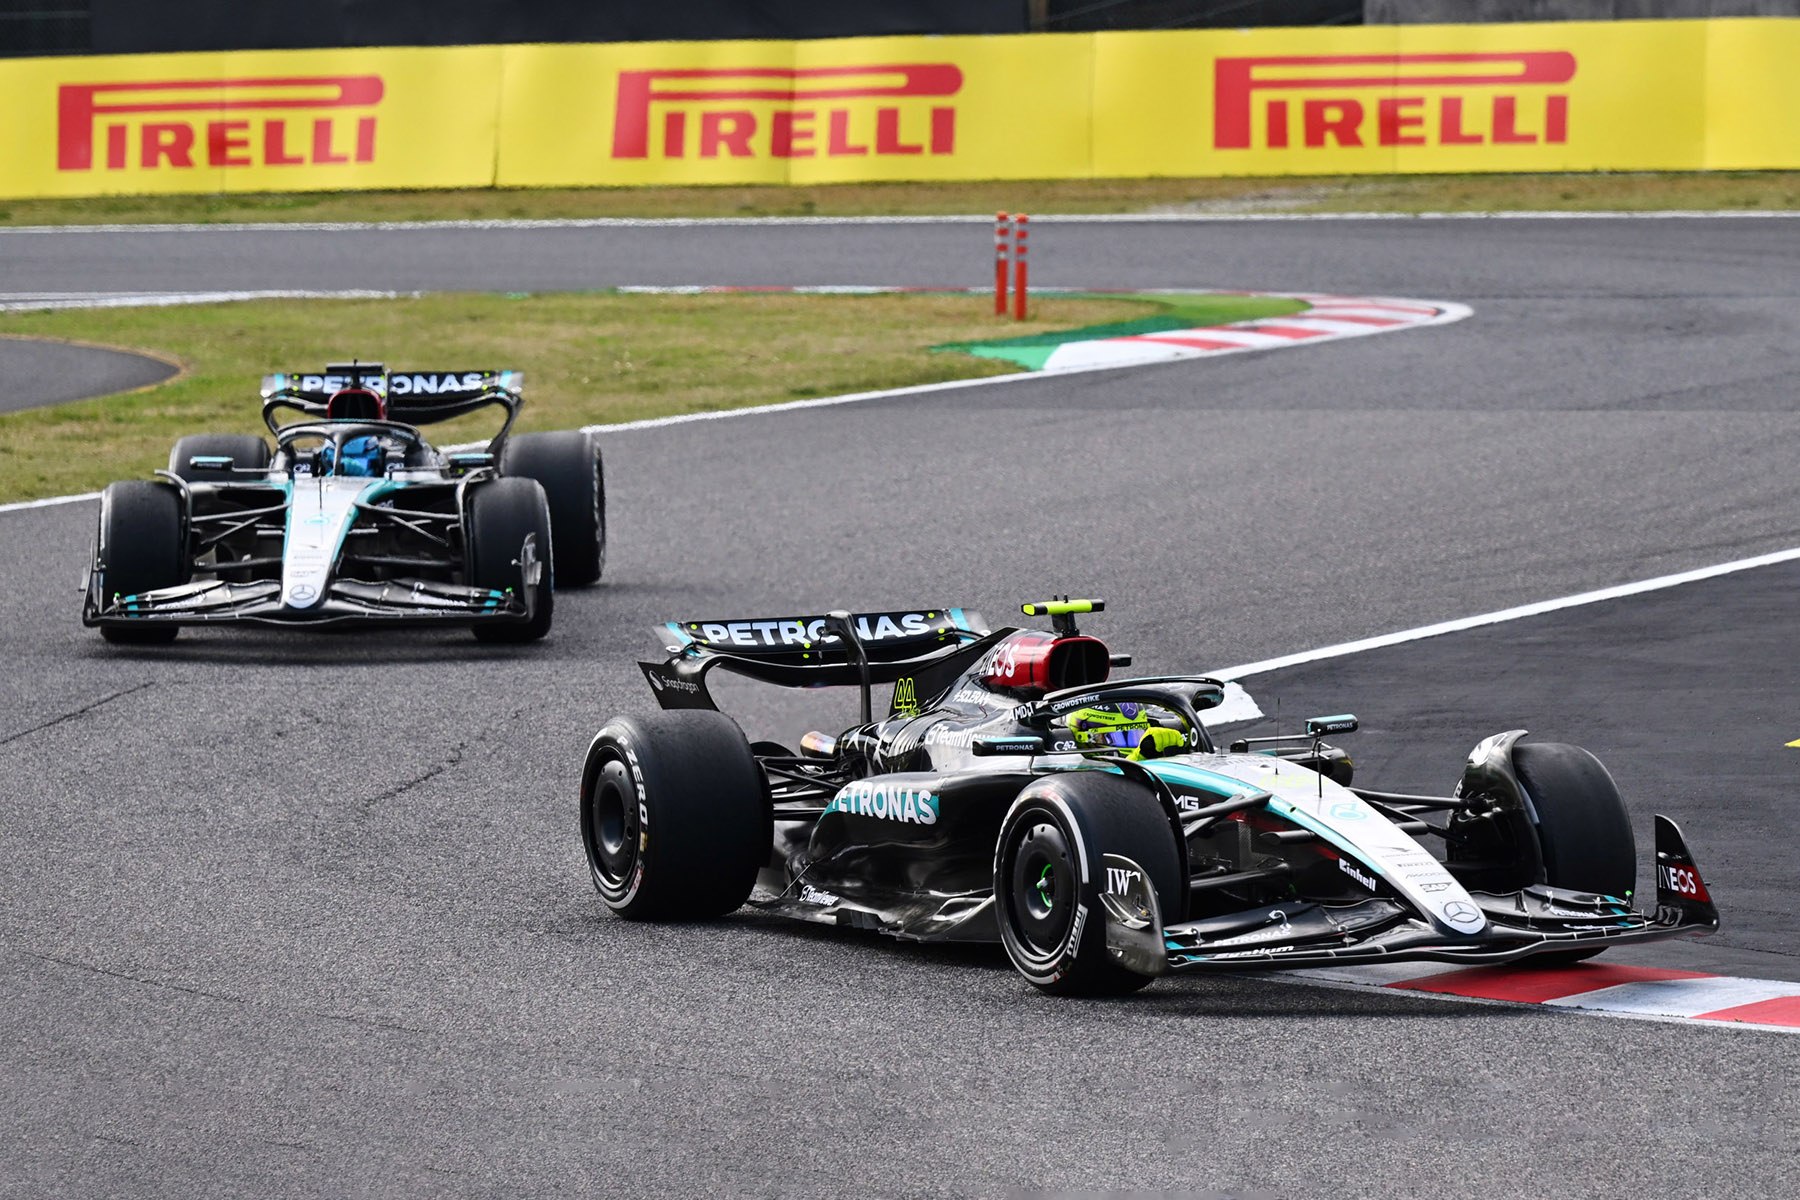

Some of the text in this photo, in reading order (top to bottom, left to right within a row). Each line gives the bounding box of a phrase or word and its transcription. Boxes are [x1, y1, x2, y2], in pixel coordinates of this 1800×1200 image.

[610, 63, 964, 160] PIRELLI
[1213, 50, 1577, 151] PIRELLI
[57, 74, 386, 171] PIRELLI
[702, 614, 930, 646] PETRONAS
[661, 674, 699, 694] Snapdragon
[894, 678, 916, 709] 44
[1008, 702, 1029, 722] AMD
[1054, 694, 1100, 711] CROWDSTRIKE
[1326, 722, 1354, 731] PETRONAS
[616, 735, 629, 745] P
[625, 749, 649, 826] ZERO
[1165, 794, 1199, 810] MG
[1338, 858, 1377, 892] Einhell
[1658, 864, 1697, 895] INEOS
[1066, 903, 1089, 959] PIRELLI
